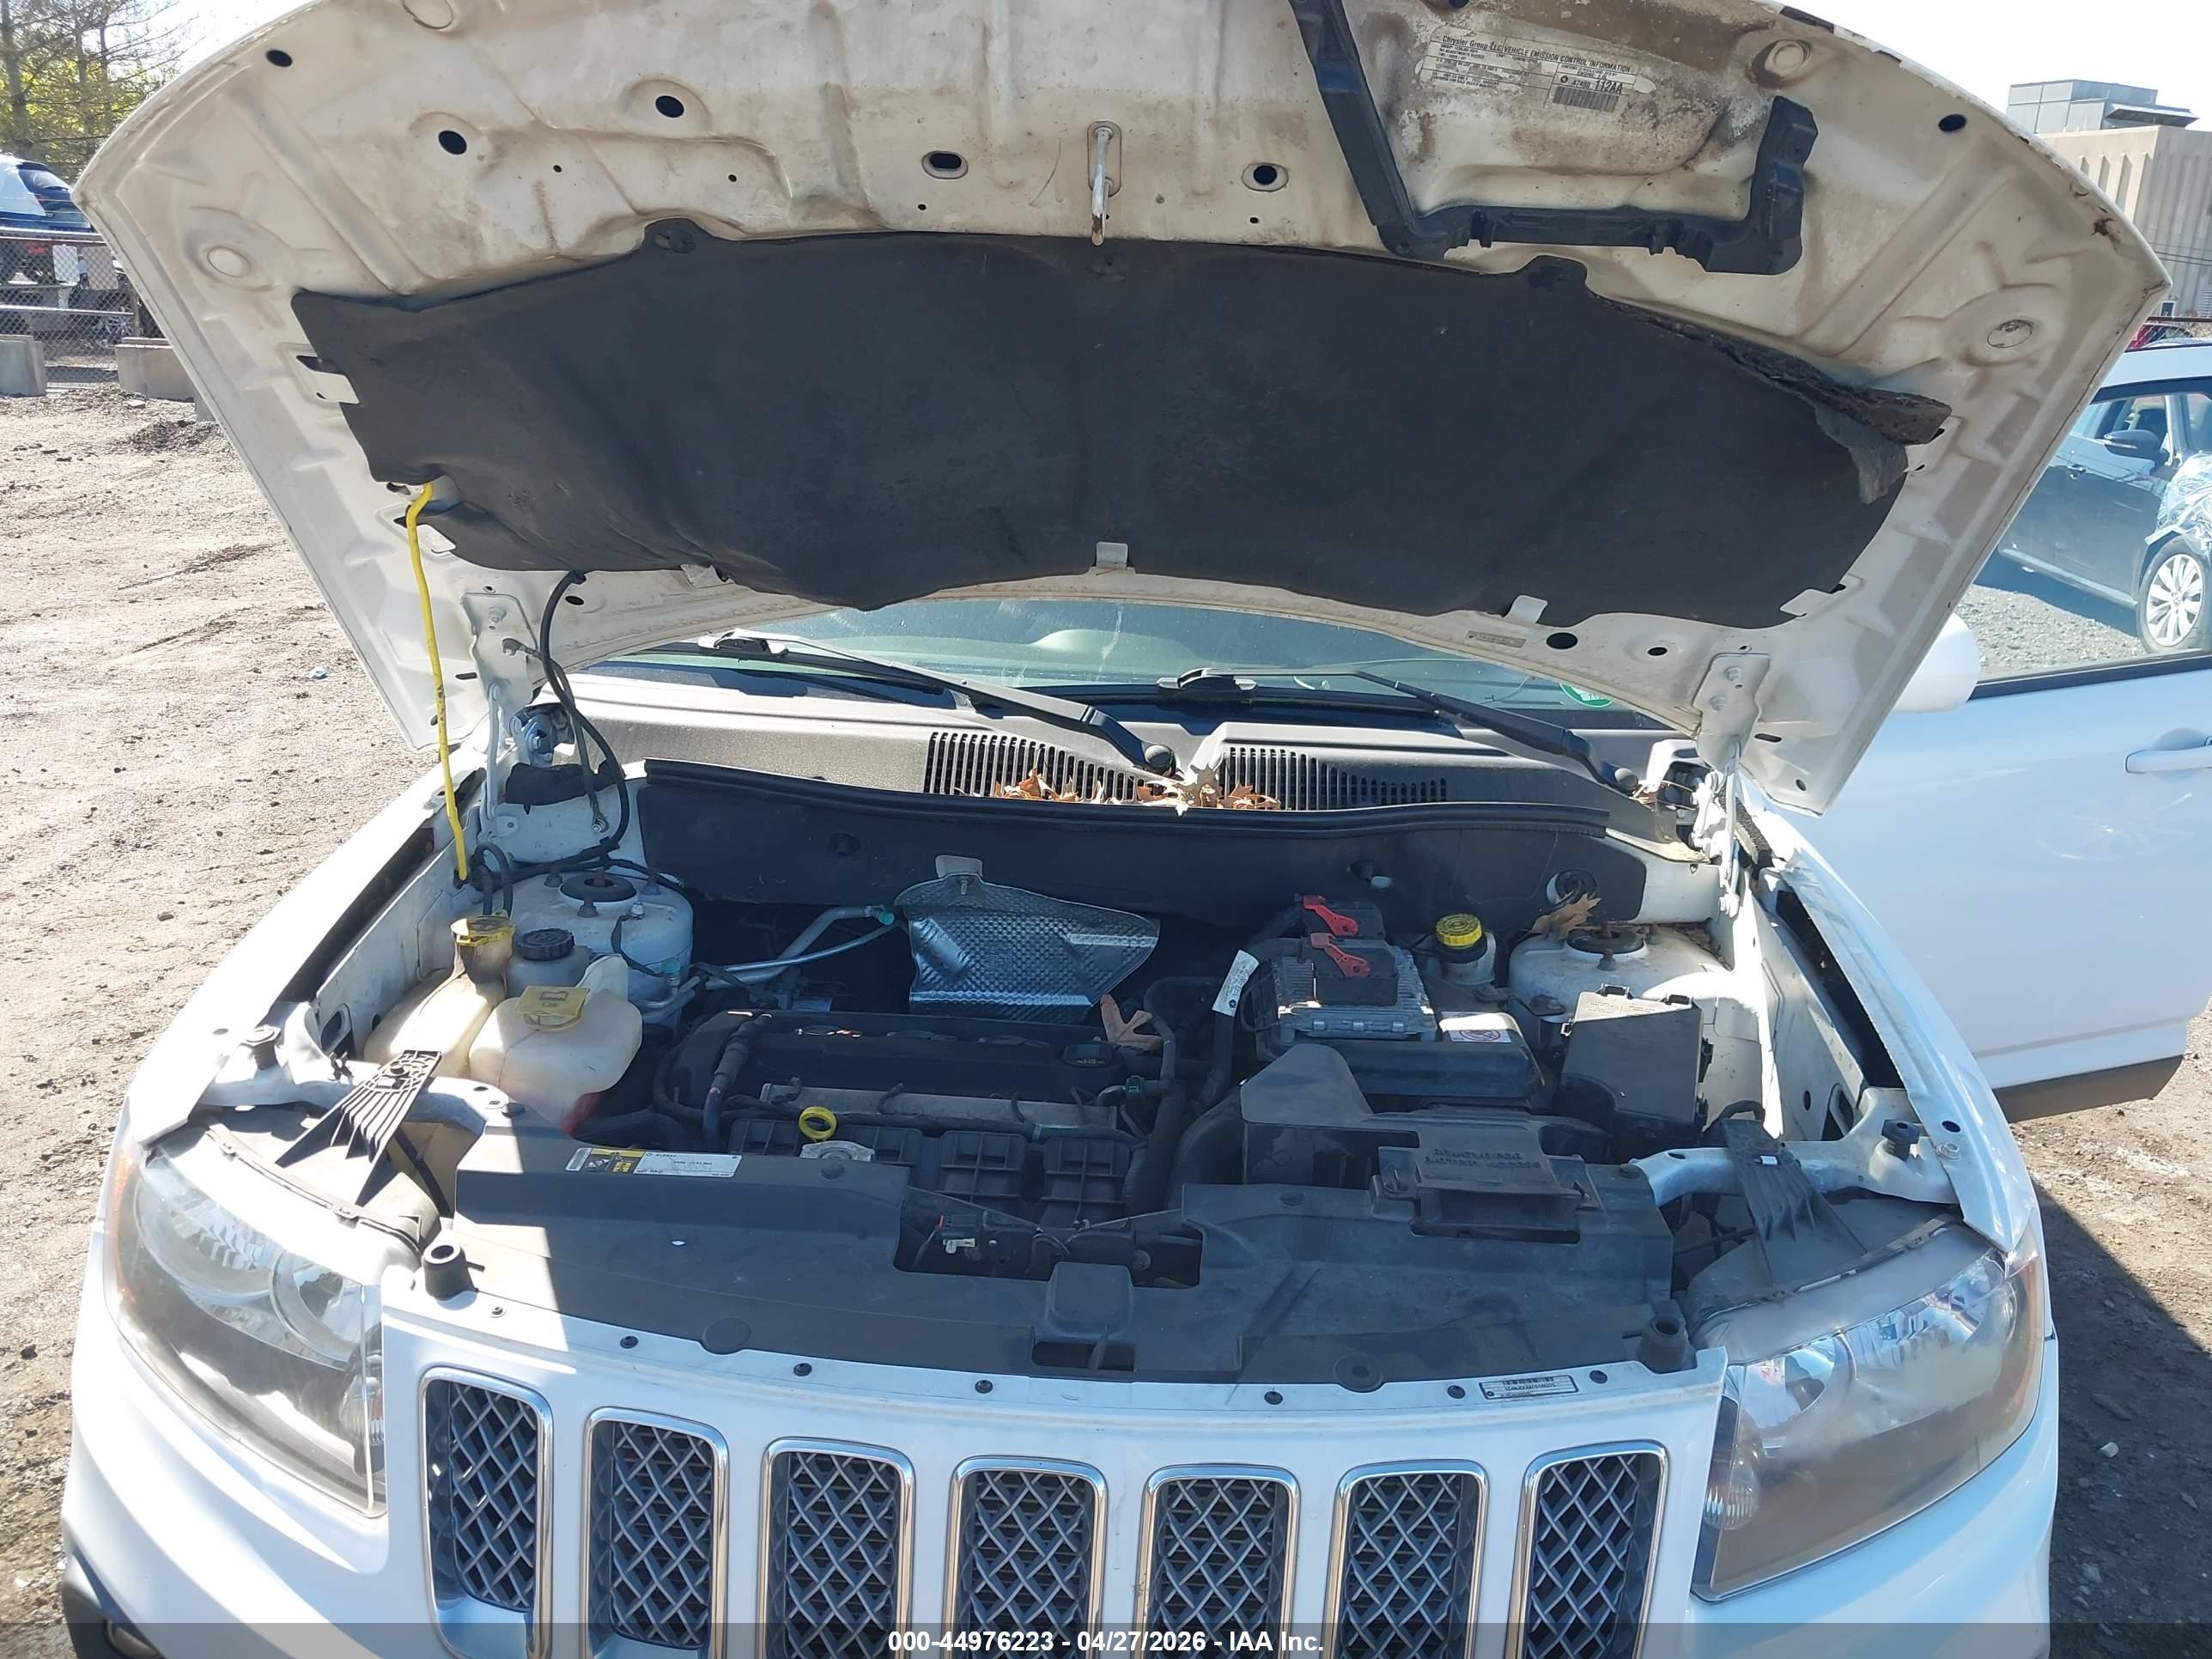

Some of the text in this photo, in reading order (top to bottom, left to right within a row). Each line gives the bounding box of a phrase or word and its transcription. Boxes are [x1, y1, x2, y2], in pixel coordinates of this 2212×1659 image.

[1442, 35, 1468, 46] Chrysler
[1469, 40, 1488, 50] Group
[1489, 40, 1502, 52] LLC
[1503, 44, 1529, 56] VEHICLE
[1529, 50, 1559, 62] EMISSION
[1559, 55, 1587, 66] CONTROL
[1589, 60, 1632, 74] INFORMATION
[1595, 79, 1623, 95] 112AA
